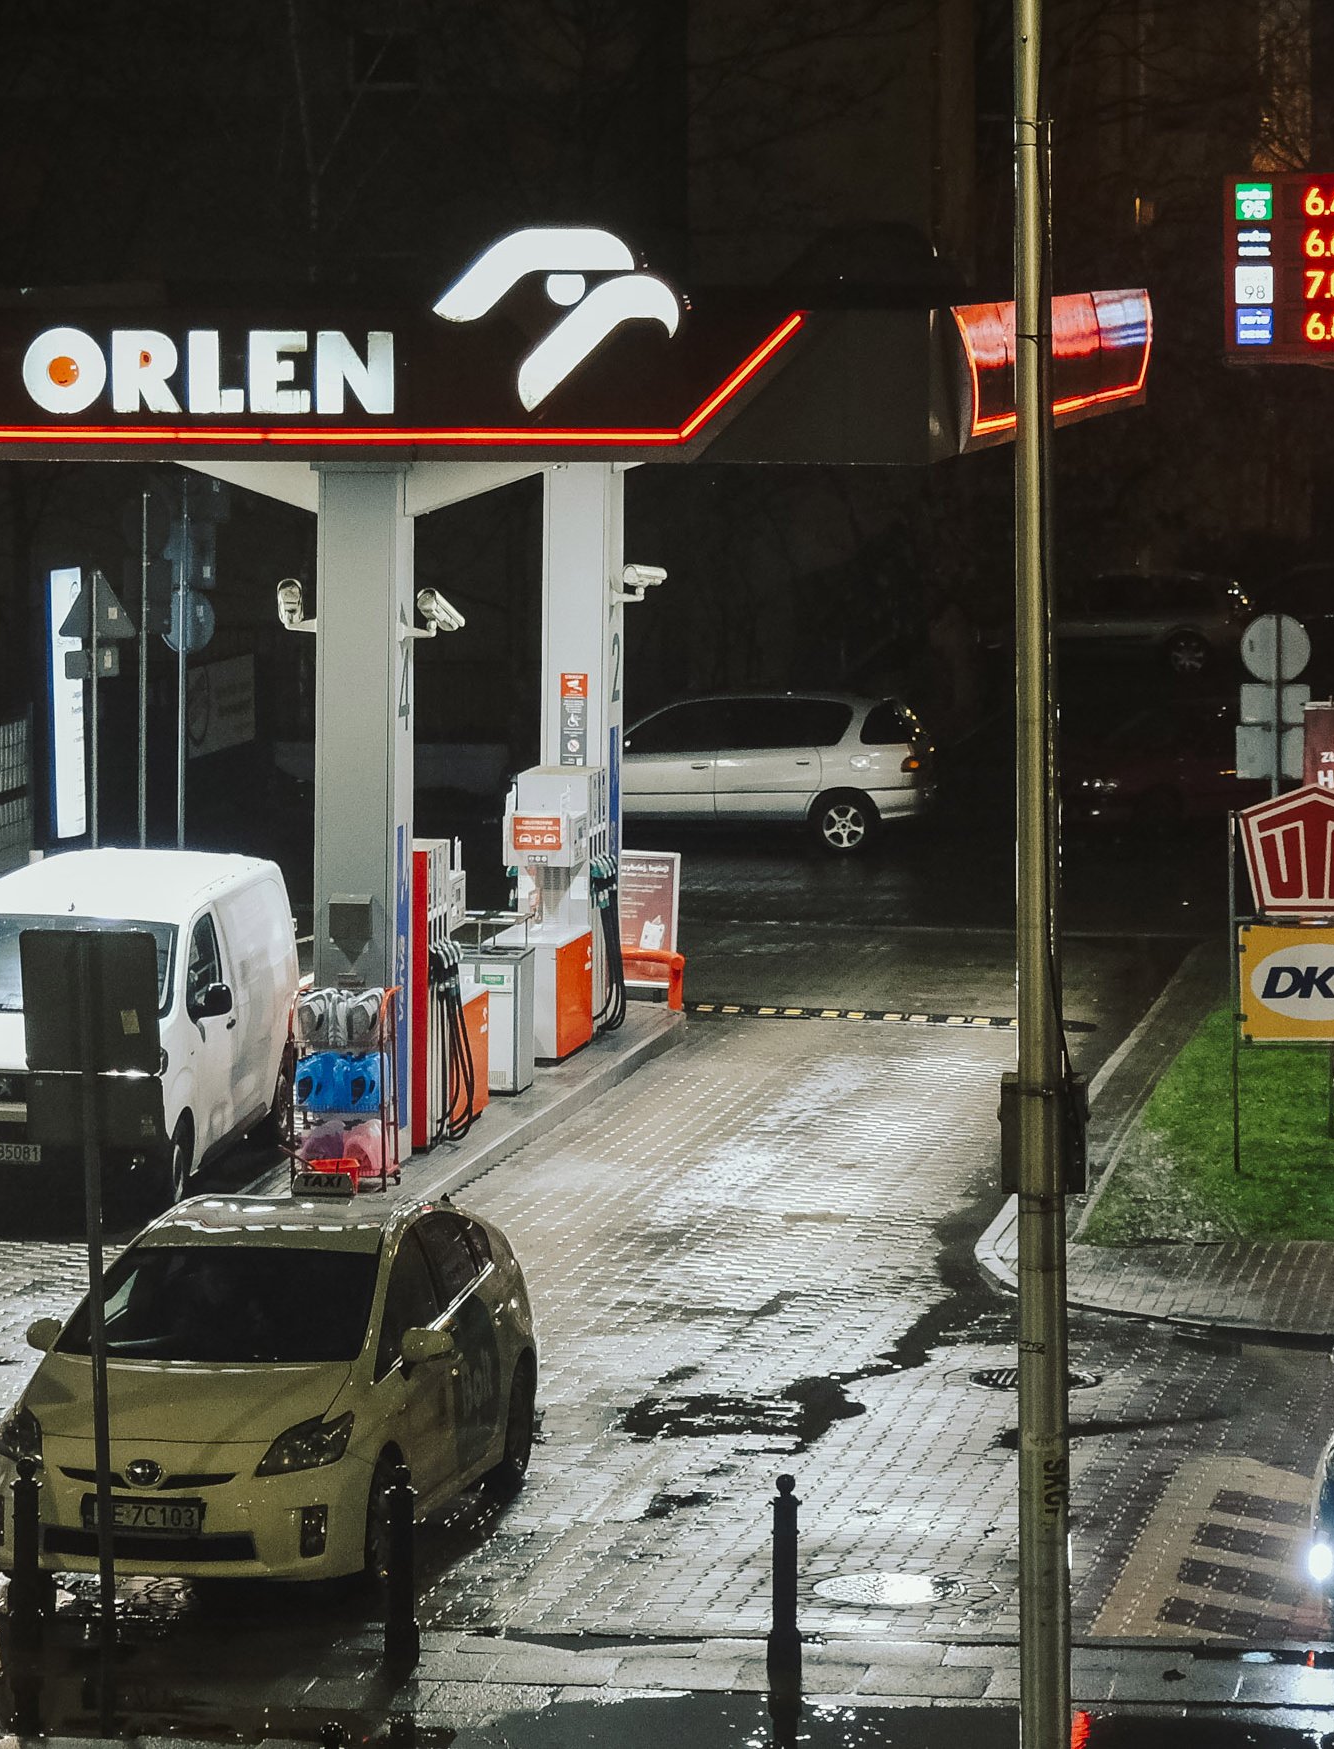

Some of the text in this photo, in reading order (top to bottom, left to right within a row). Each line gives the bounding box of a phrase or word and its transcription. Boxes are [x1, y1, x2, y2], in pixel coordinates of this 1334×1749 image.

[1241, 200, 1267, 218] 95
[1245, 285, 1266, 299] 98
[23, 327, 395, 415] ORLEN
[303, 1175, 343, 1188] TAXI
[132, 1505, 196, 1527] 7C103
